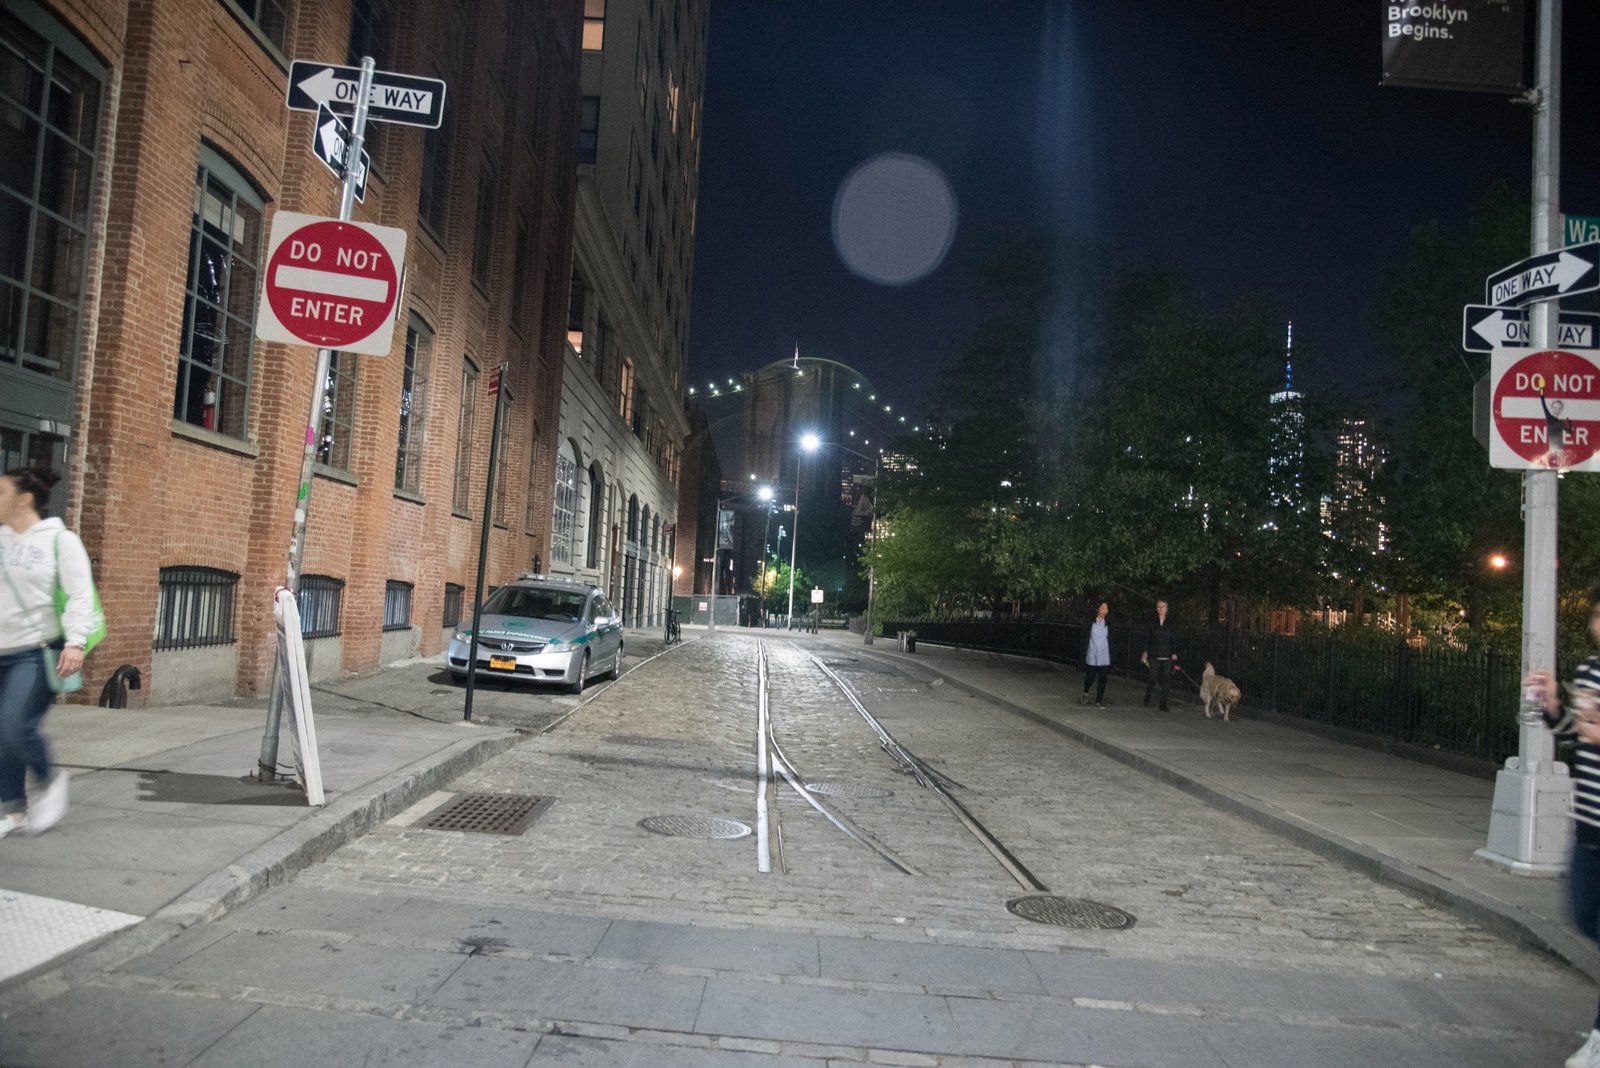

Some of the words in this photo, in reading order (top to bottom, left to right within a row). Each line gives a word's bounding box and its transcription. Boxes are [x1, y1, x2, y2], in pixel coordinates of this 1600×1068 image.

[1388, 3, 1468, 24] Brooklyn
[1388, 22, 1453, 41] Begins.
[384, 88, 427, 110] WAY
[290, 240, 322, 262] DO
[336, 248, 382, 271] NOT
[1495, 278, 1518, 302] ONE
[1522, 265, 1556, 291] WAY
[290, 298, 364, 326] ENTER
[1506, 322, 1530, 340] ON
[1559, 325, 1586, 344] AY
[1515, 372, 1546, 392] DO
[1553, 373, 1595, 393] NOT
[1520, 424, 1589, 446] ENER
